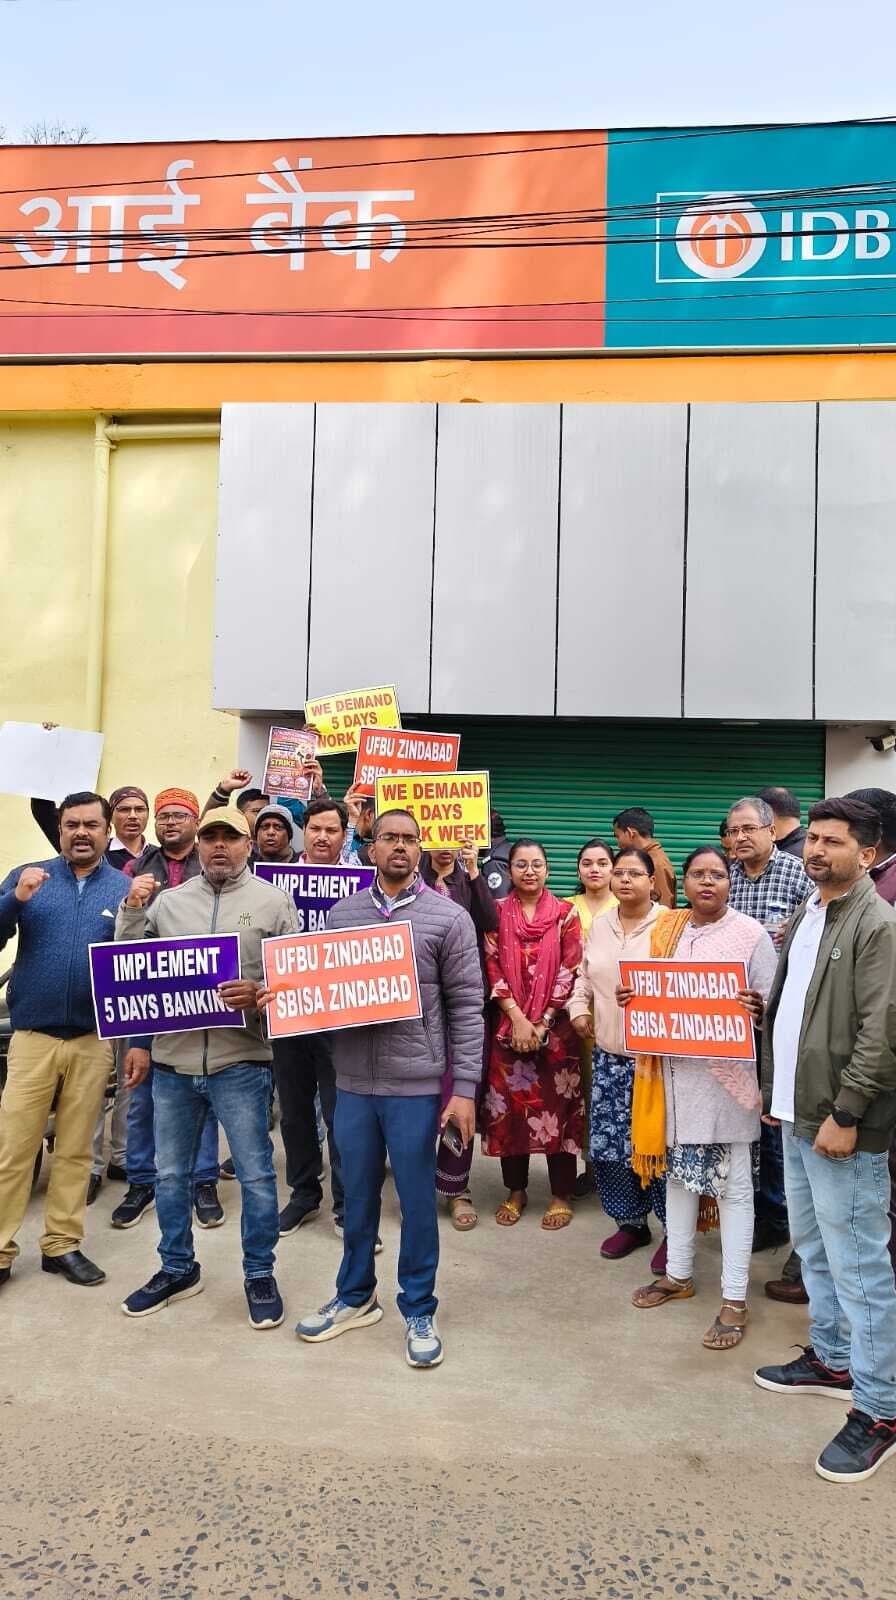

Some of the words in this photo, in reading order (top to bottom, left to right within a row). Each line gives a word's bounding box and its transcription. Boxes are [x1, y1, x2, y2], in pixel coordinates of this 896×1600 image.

[13, 160, 201, 290] आई
[246, 156, 415, 271] बैंक
[311, 703, 332, 716] WE
[335, 693, 393, 712] DEMAND
[331, 716, 340, 730] 5
[344, 712, 378, 728] DAYS
[365, 736, 395, 757] UFBU
[397, 739, 453, 763] ZINDABAD
[382, 783, 407, 801] WE
[413, 781, 483, 800] DEMAND
[406, 805, 415, 817] 5
[420, 804, 463, 821] DAYS
[439, 824, 486, 842] WEEK
[272, 873, 361, 898] IMPLEMENT
[113, 947, 221, 982] IMPLEMENT
[275, 944, 319, 975] UFBU
[323, 934, 405, 969] ZINDABAD
[276, 985, 325, 1019] SBISA
[328, 974, 412, 1011] ZINDABAD
[628, 970, 662, 998] UFBU
[665, 971, 739, 999] ZINDABAD
[104, 997, 115, 1023] 5
[117, 994, 159, 1022] DAYS
[162, 989, 235, 1018] BANKIN
[630, 1010, 668, 1038] SBISA
[670, 1013, 746, 1042] ZINDABAD
